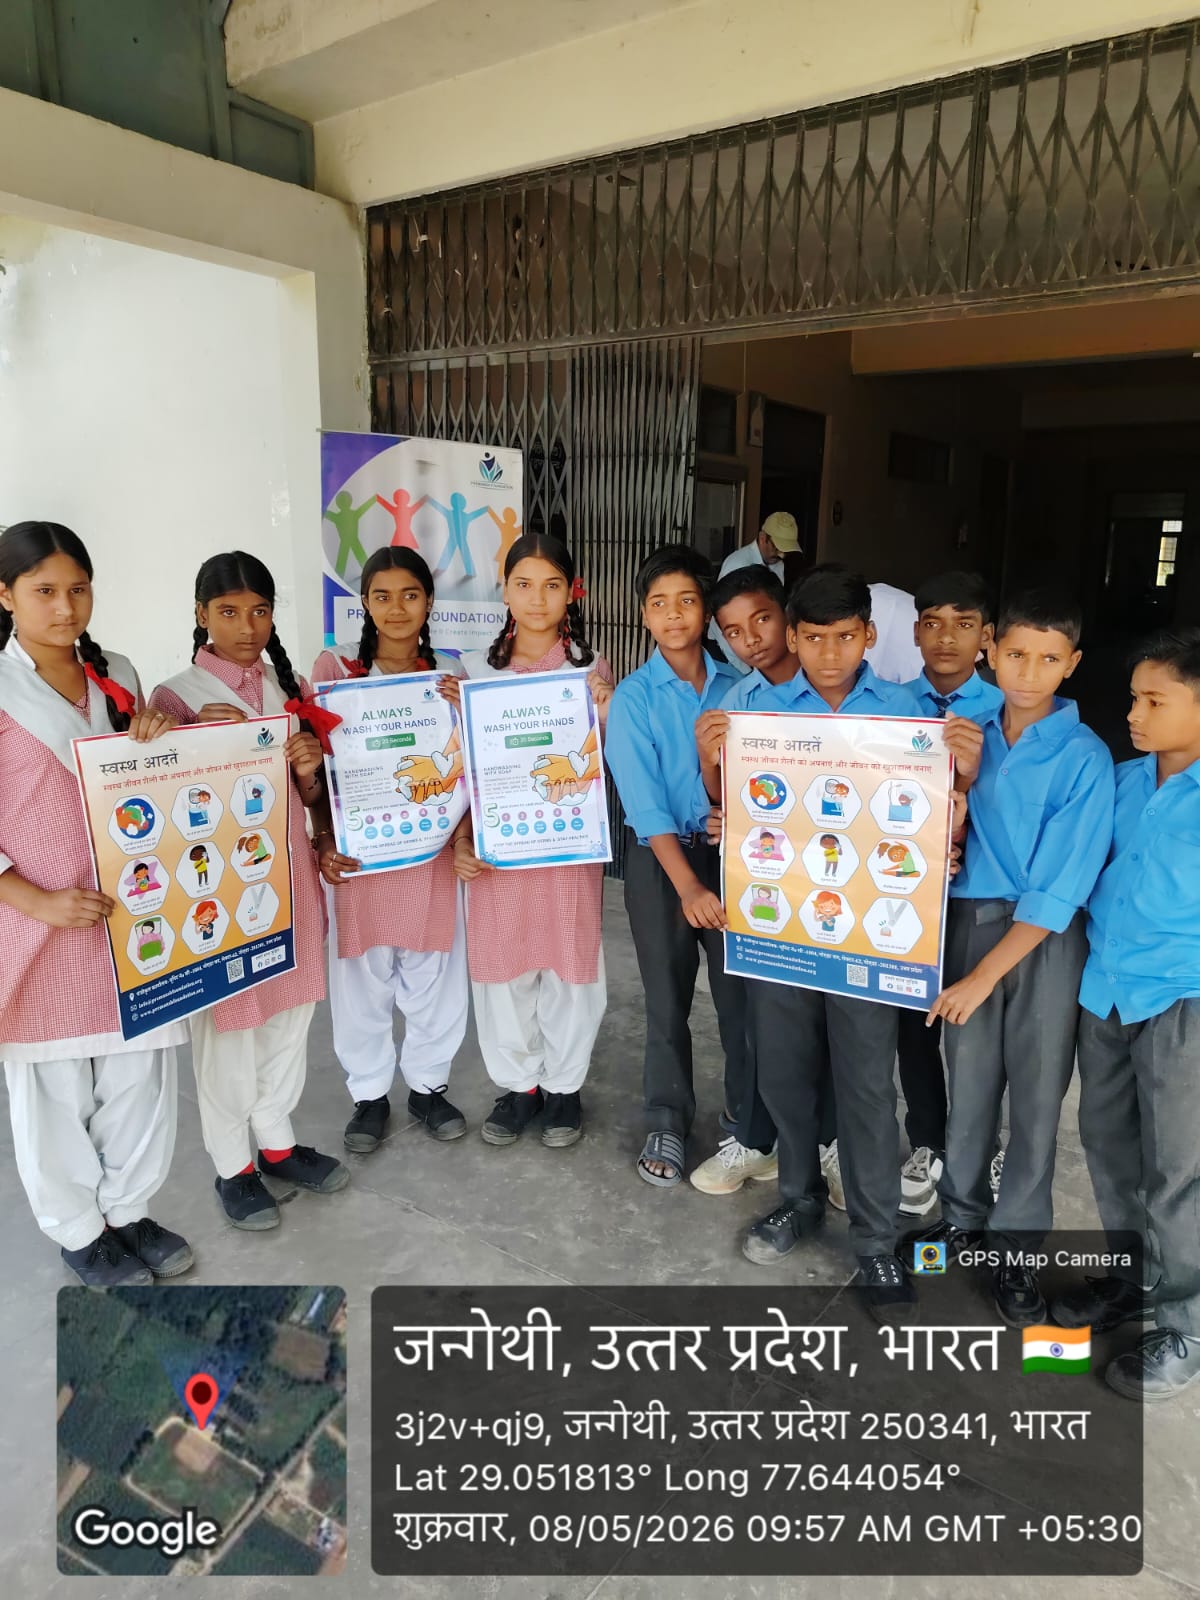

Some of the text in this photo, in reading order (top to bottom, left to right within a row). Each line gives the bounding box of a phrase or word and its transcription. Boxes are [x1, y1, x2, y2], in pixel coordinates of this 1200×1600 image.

[431, 611, 505, 625] OUNDATION
[361, 706, 413, 721] ALWAYS
[502, 705, 551, 719] ALWAYS
[343, 718, 437, 736] WASH YOUR HANDS
[484, 717, 575, 733] WASH YOUR HANDS
[741, 736, 822, 754] स्वस्थ आदतें
[99, 748, 180, 776] स्वस्थ आदतें
[345, 805, 364, 831] 5
[483, 803, 500, 828] 5
